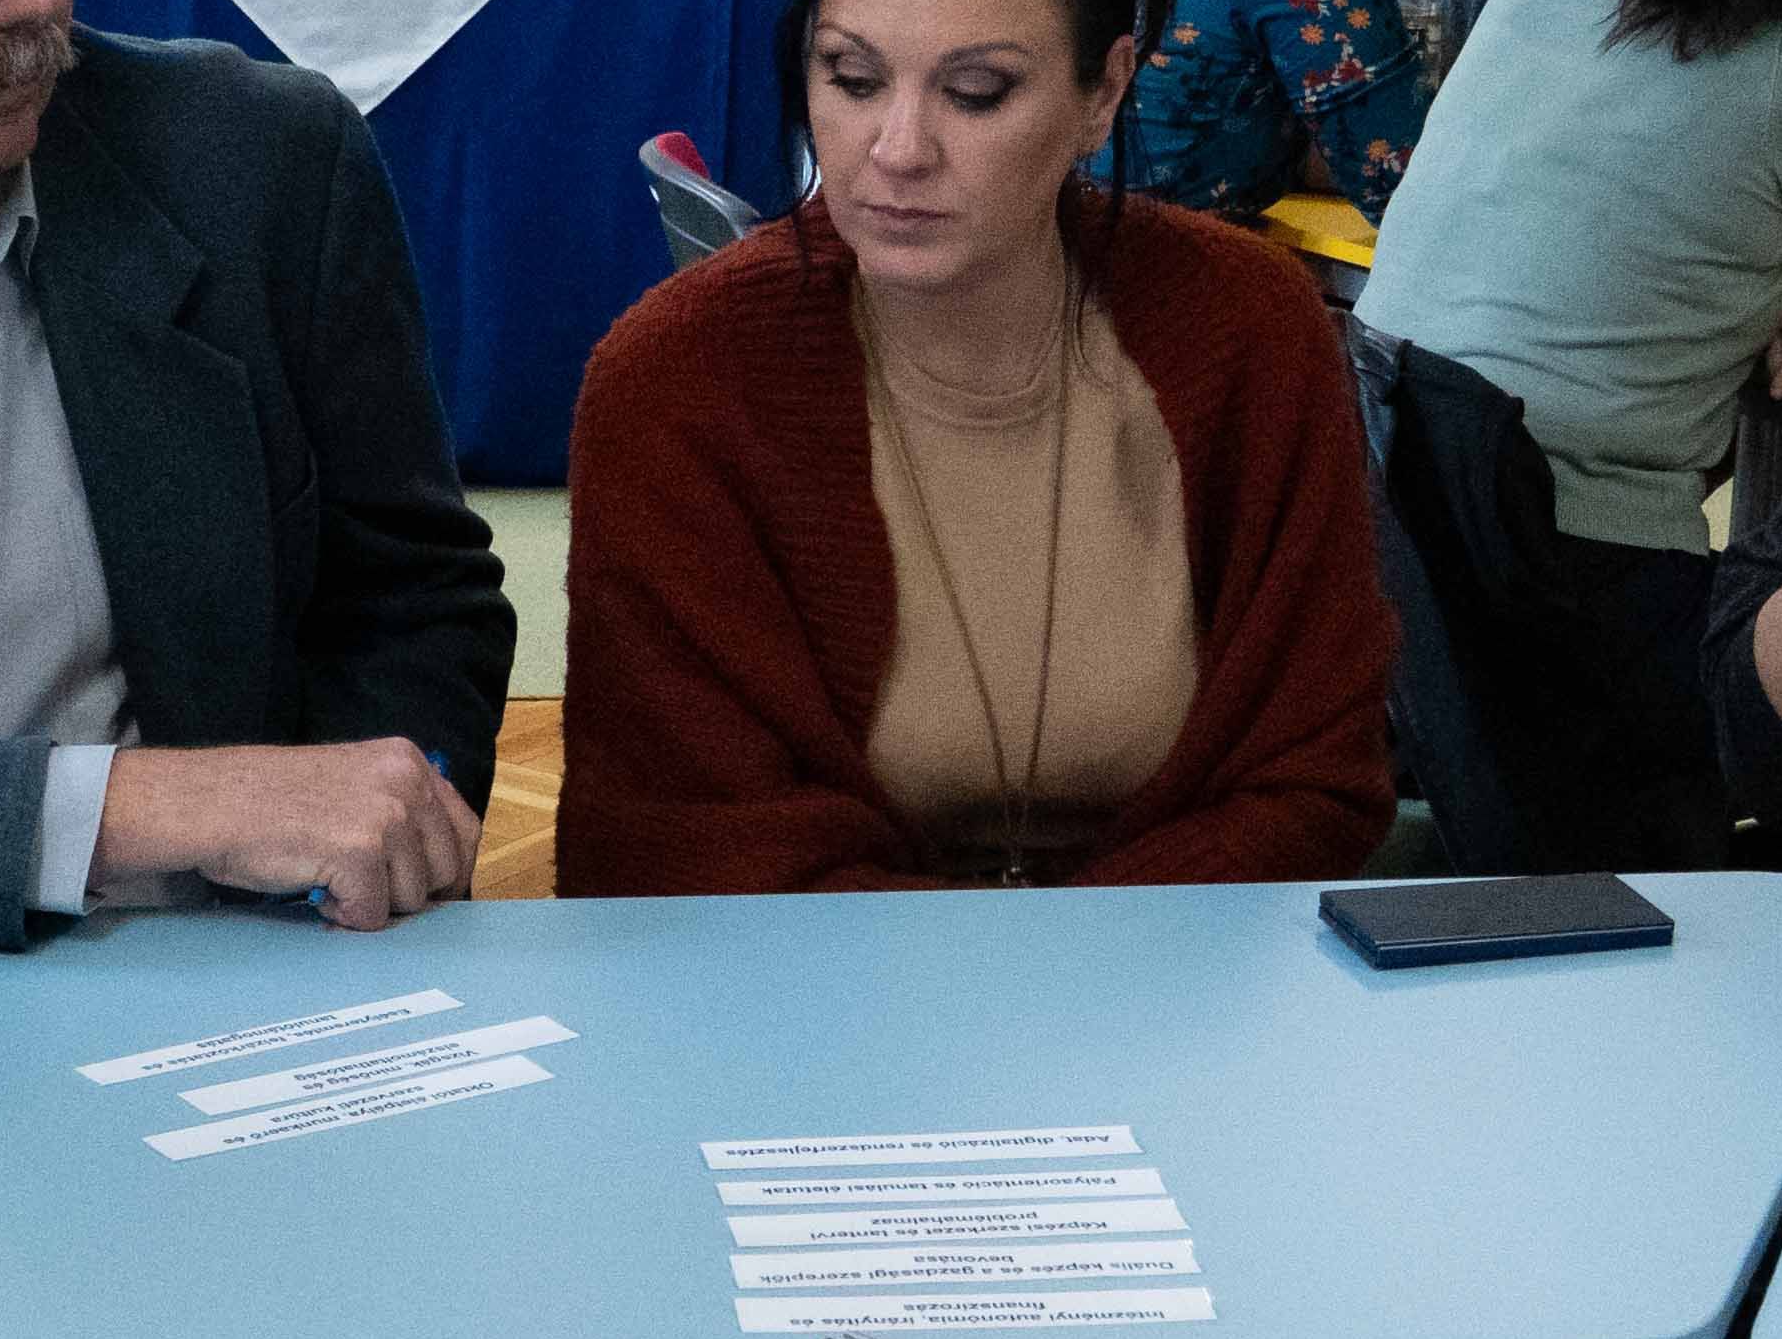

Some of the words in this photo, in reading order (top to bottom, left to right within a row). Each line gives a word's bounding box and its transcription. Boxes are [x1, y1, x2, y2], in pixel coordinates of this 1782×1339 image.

[910, 1141, 934, 1149] és
[938, 1135, 1055, 1150] digitalizáció
[725, 1141, 906, 1157] rendszerfejlesztés
[848, 1181, 929, 1193] tanulási
[934, 1181, 956, 1189] és
[961, 1176, 1118, 1190] Pályaorientáció
[870, 1211, 1040, 1228] problémahalmaz
[895, 1228, 919, 1236] és
[925, 1224, 1021, 1236] szerkezet
[1027, 1220, 1108, 1232] Képzési
[809, 1228, 890, 1241] tantervi
[913, 1254, 1015, 1264] bevonása
[869, 1264, 975, 1280] gazdasági
[1000, 1266, 1024, 1274] és
[1030, 1262, 1104, 1273] képzés
[1109, 1261, 1175, 1271] Duális
[821, 1315, 915, 1327] irányítás
[1049, 1310, 1167, 1322] Intézményi
[789, 1318, 815, 1327] és
